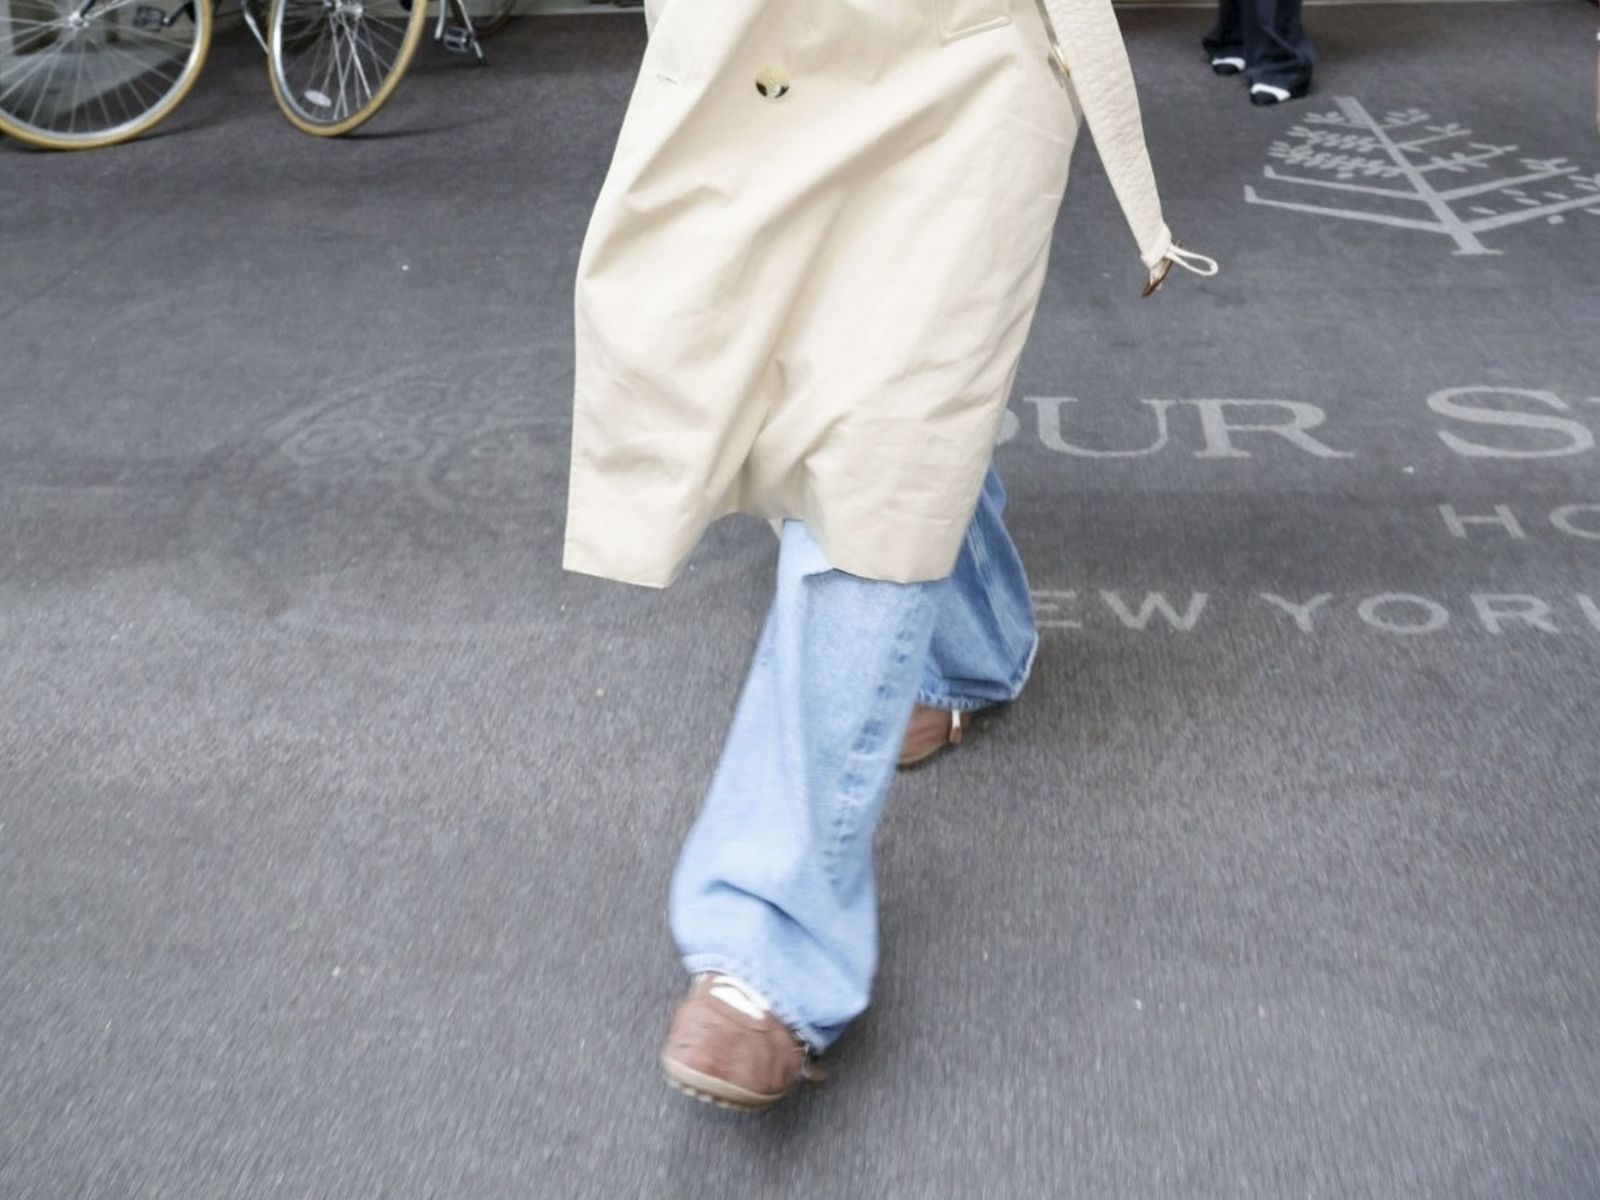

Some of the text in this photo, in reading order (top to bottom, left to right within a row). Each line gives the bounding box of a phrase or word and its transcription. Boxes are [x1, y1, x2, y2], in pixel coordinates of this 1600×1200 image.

[995, 385, 1600, 459] UR S
[1031, 588, 1210, 632] EW
